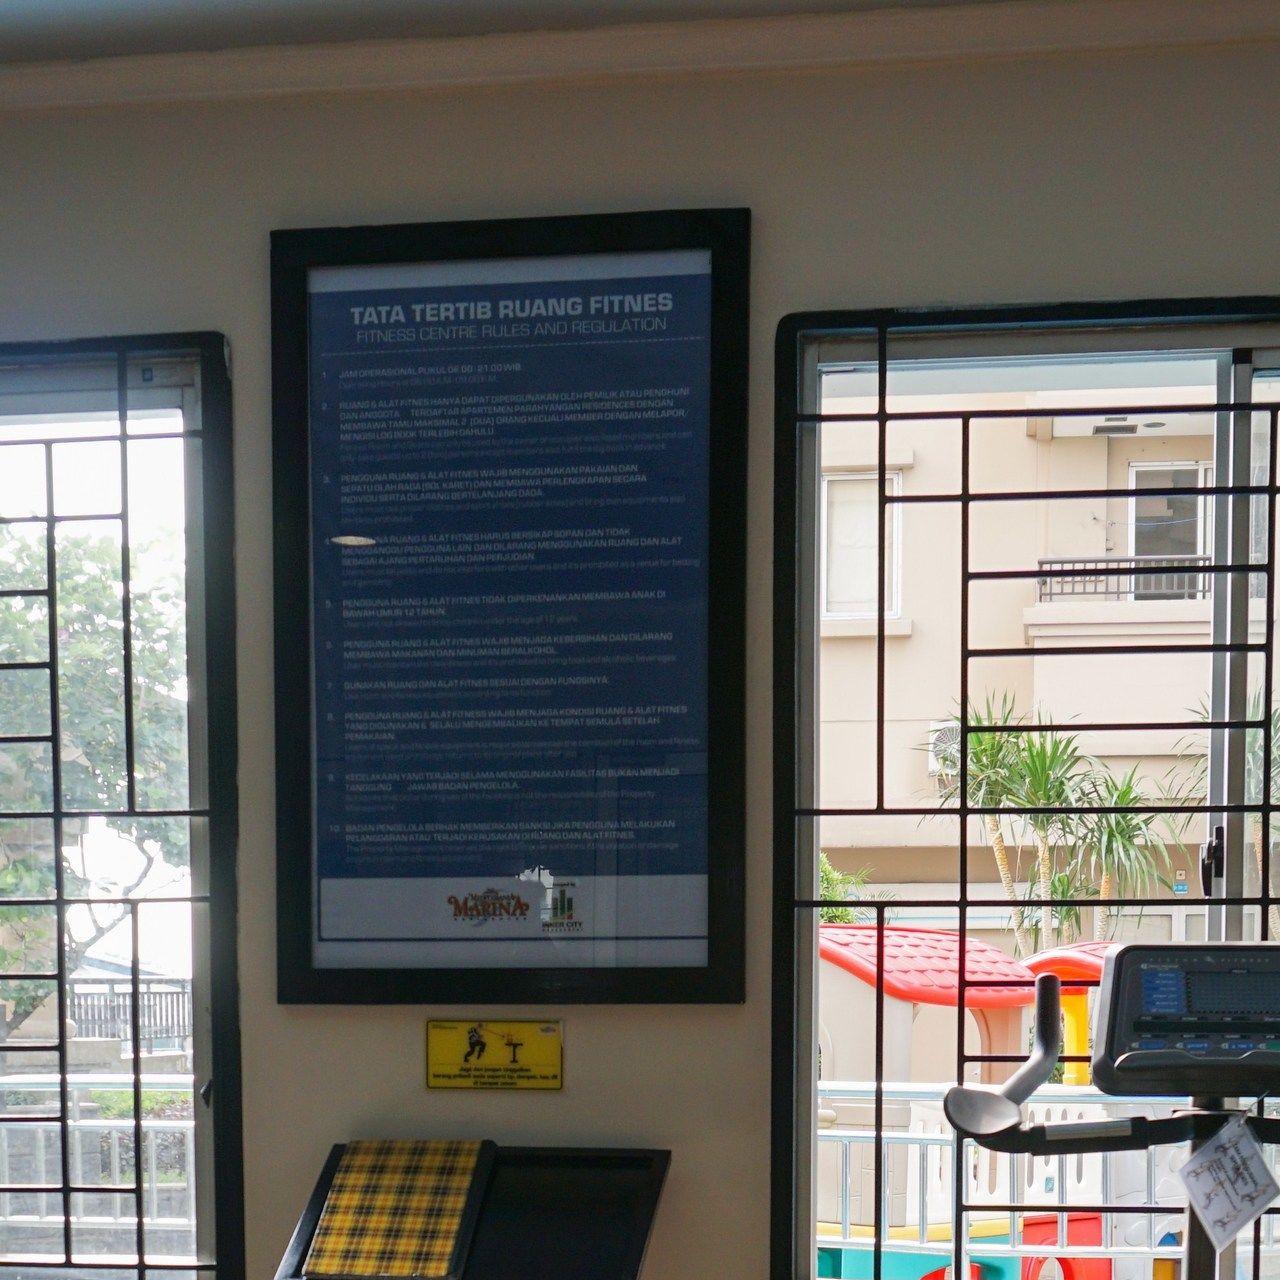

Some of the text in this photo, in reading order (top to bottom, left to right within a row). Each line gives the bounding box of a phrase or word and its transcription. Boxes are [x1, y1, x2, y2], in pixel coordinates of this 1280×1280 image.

[350, 293, 673, 325] TATA TERTIB RUANG FITNES
[356, 316, 666, 344] FITNESS CENTRE RULES AND REGULATION
[447, 895, 530, 916] MARINA
